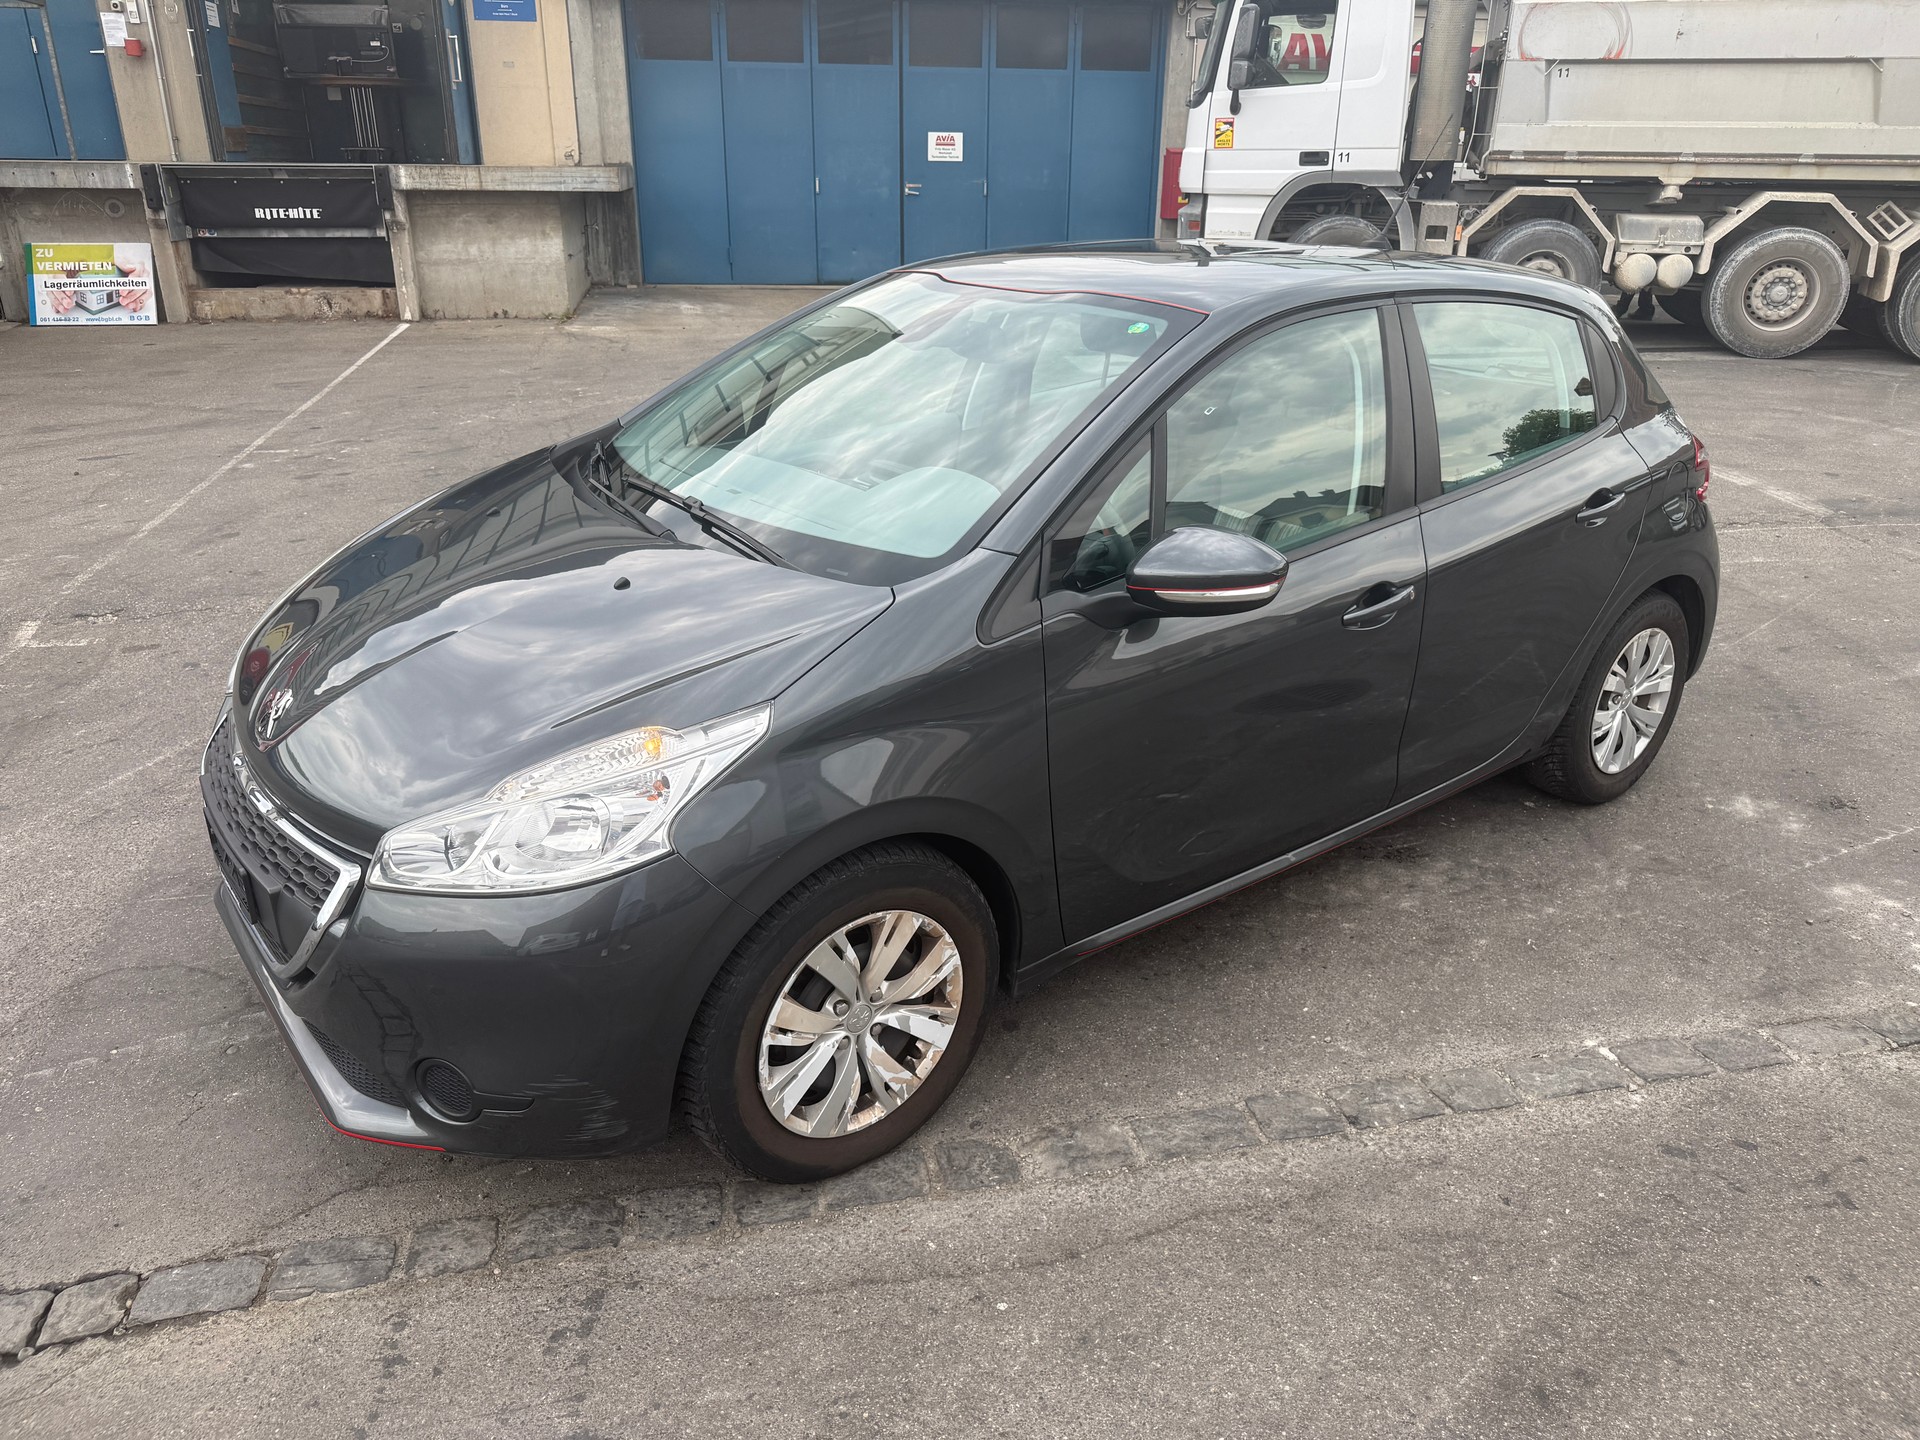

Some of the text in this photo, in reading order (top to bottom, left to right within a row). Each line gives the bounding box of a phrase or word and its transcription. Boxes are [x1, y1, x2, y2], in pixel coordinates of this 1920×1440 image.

[1557, 67, 1570, 78] 11
[936, 134, 955, 142] AVIA
[1337, 152, 1351, 163] 11
[35, 248, 54, 258] ZU
[36, 261, 113, 271] VERMIETEN
[43, 279, 148, 290] Lagerräumlichkeiten
